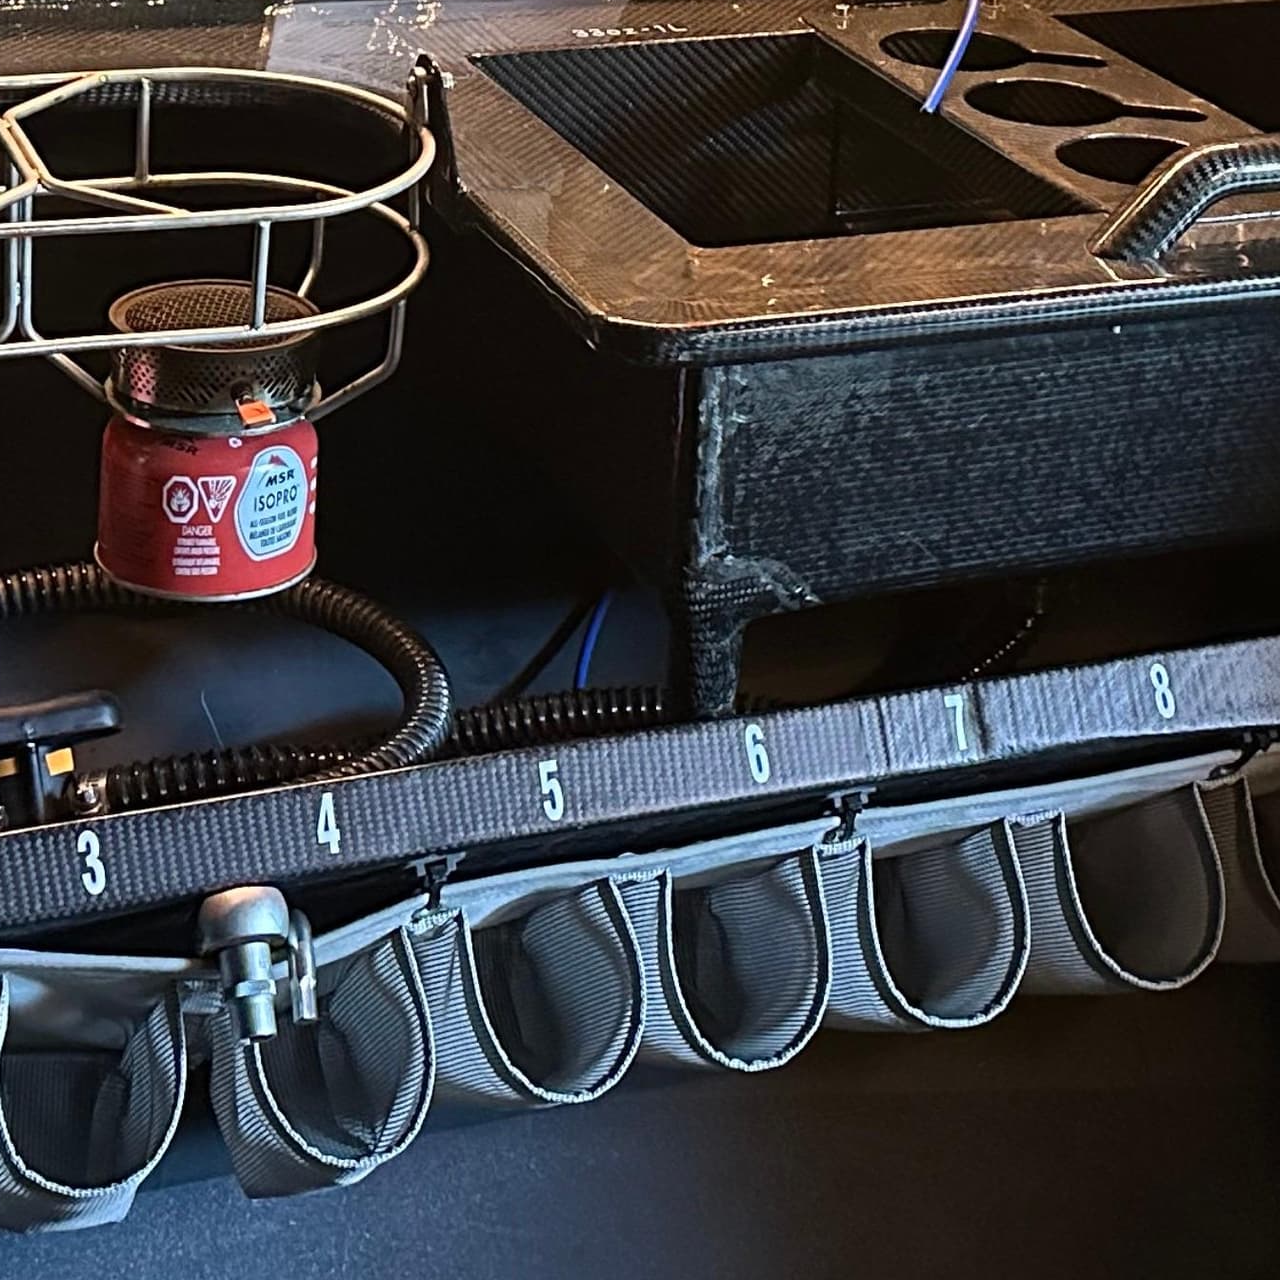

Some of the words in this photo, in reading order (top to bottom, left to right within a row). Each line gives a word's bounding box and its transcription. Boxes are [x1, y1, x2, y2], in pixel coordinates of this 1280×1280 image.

[254, 485, 298, 512] ISOPRO
[265, 469, 295, 487] MSR
[182, 525, 213, 536] DANGER
[1150, 664, 1174, 718] 8
[944, 694, 967, 750] 7
[746, 725, 769, 783] 6
[539, 760, 563, 820] 5
[318, 793, 340, 853] 4
[78, 831, 105, 895] 3
